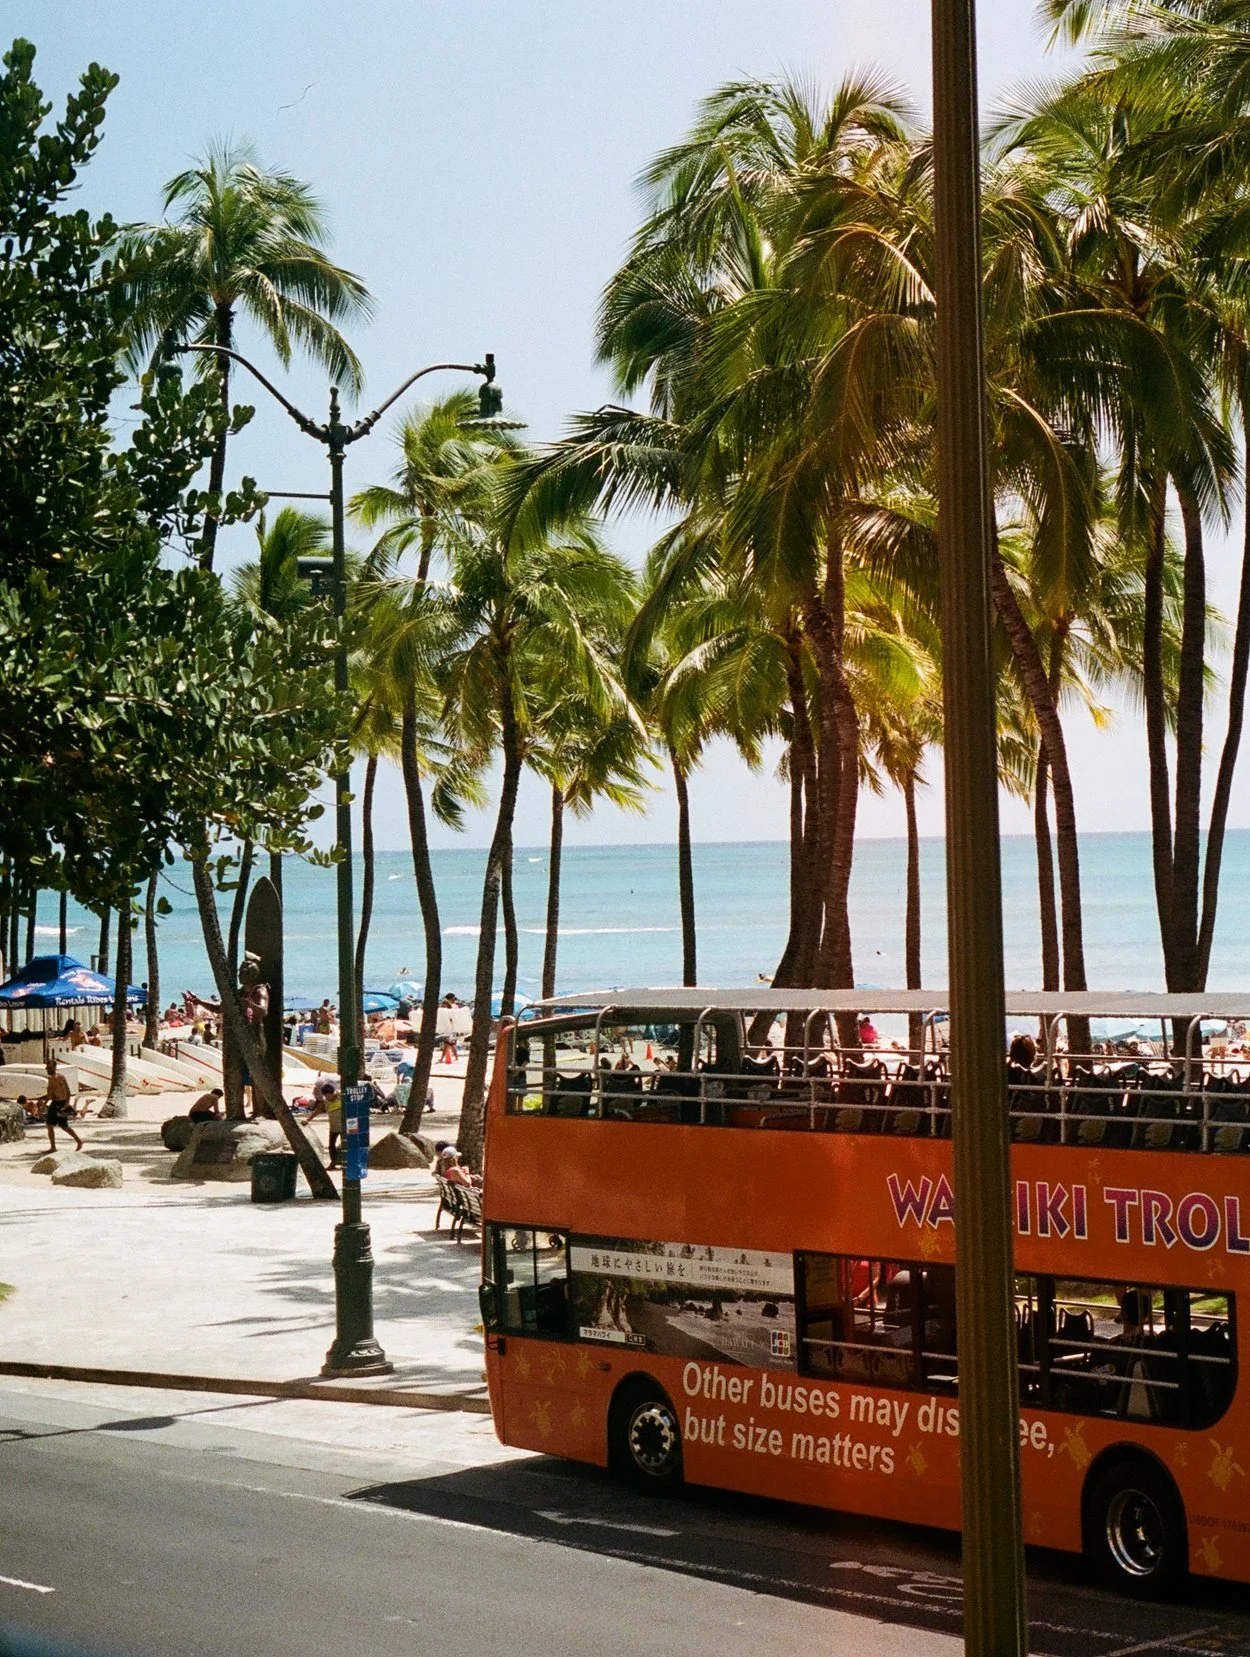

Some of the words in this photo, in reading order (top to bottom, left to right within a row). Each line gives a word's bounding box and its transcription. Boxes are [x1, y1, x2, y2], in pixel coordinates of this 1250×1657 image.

[346, 1086, 368, 1095] TROLLEY
[350, 1094, 365, 1102] STOP
[886, 1173, 1088, 1240] WAIKI
[683, 1361, 754, 1404] Other
[760, 1373, 840, 1419] buses
[850, 1394, 911, 1438] may
[917, 1397, 1055, 1458] disee,
[684, 1406, 727, 1446] but
[733, 1416, 783, 1455] size
[791, 1430, 895, 1474] matters
